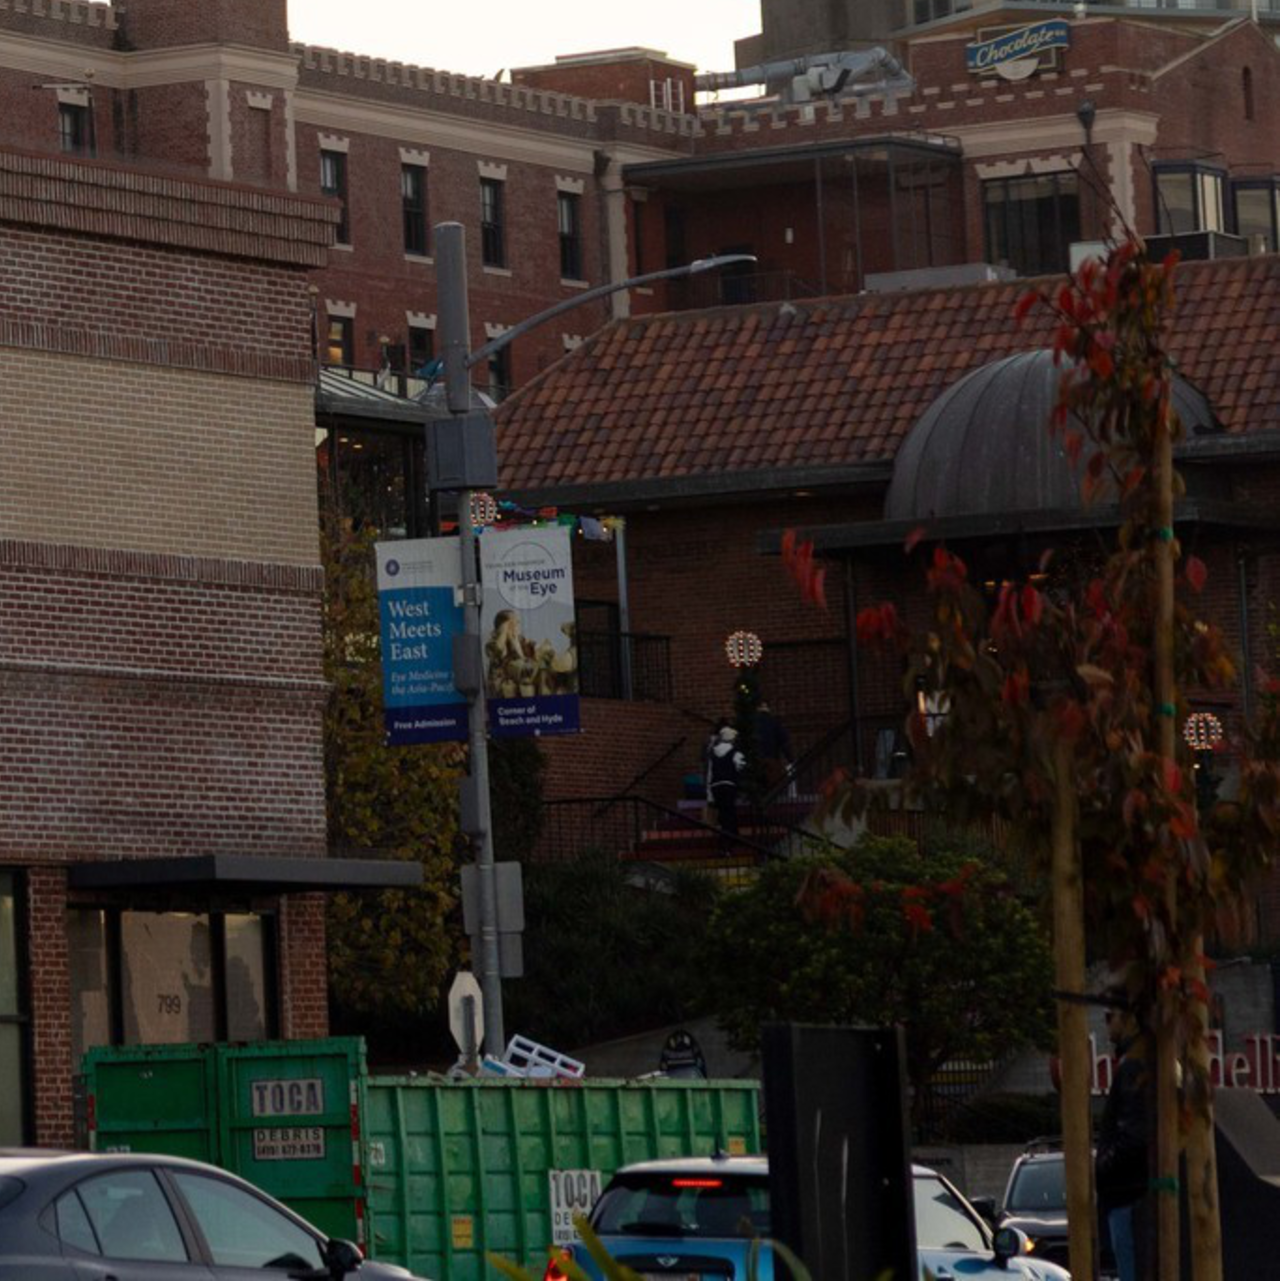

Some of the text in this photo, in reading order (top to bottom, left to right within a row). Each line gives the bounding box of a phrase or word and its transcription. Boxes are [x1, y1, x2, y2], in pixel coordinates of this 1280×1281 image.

[976, 26, 1055, 67] Chocolate
[503, 567, 565, 583] Museum
[530, 581, 558, 597] Eye
[387, 600, 430, 618] West
[389, 622, 442, 640] Meets
[390, 643, 428, 661] East
[408, 670, 449, 682] Medicine
[497, 705, 536, 716] Corner of
[394, 718, 456, 730] Free Admission
[525, 715, 541, 725] and
[541, 714, 563, 725] Hyde
[157, 993, 181, 1014] 799
[255, 1082, 319, 1113] TOCA
[256, 1128, 320, 1142] DEBRIS
[552, 1173, 599, 1208] TOCA
